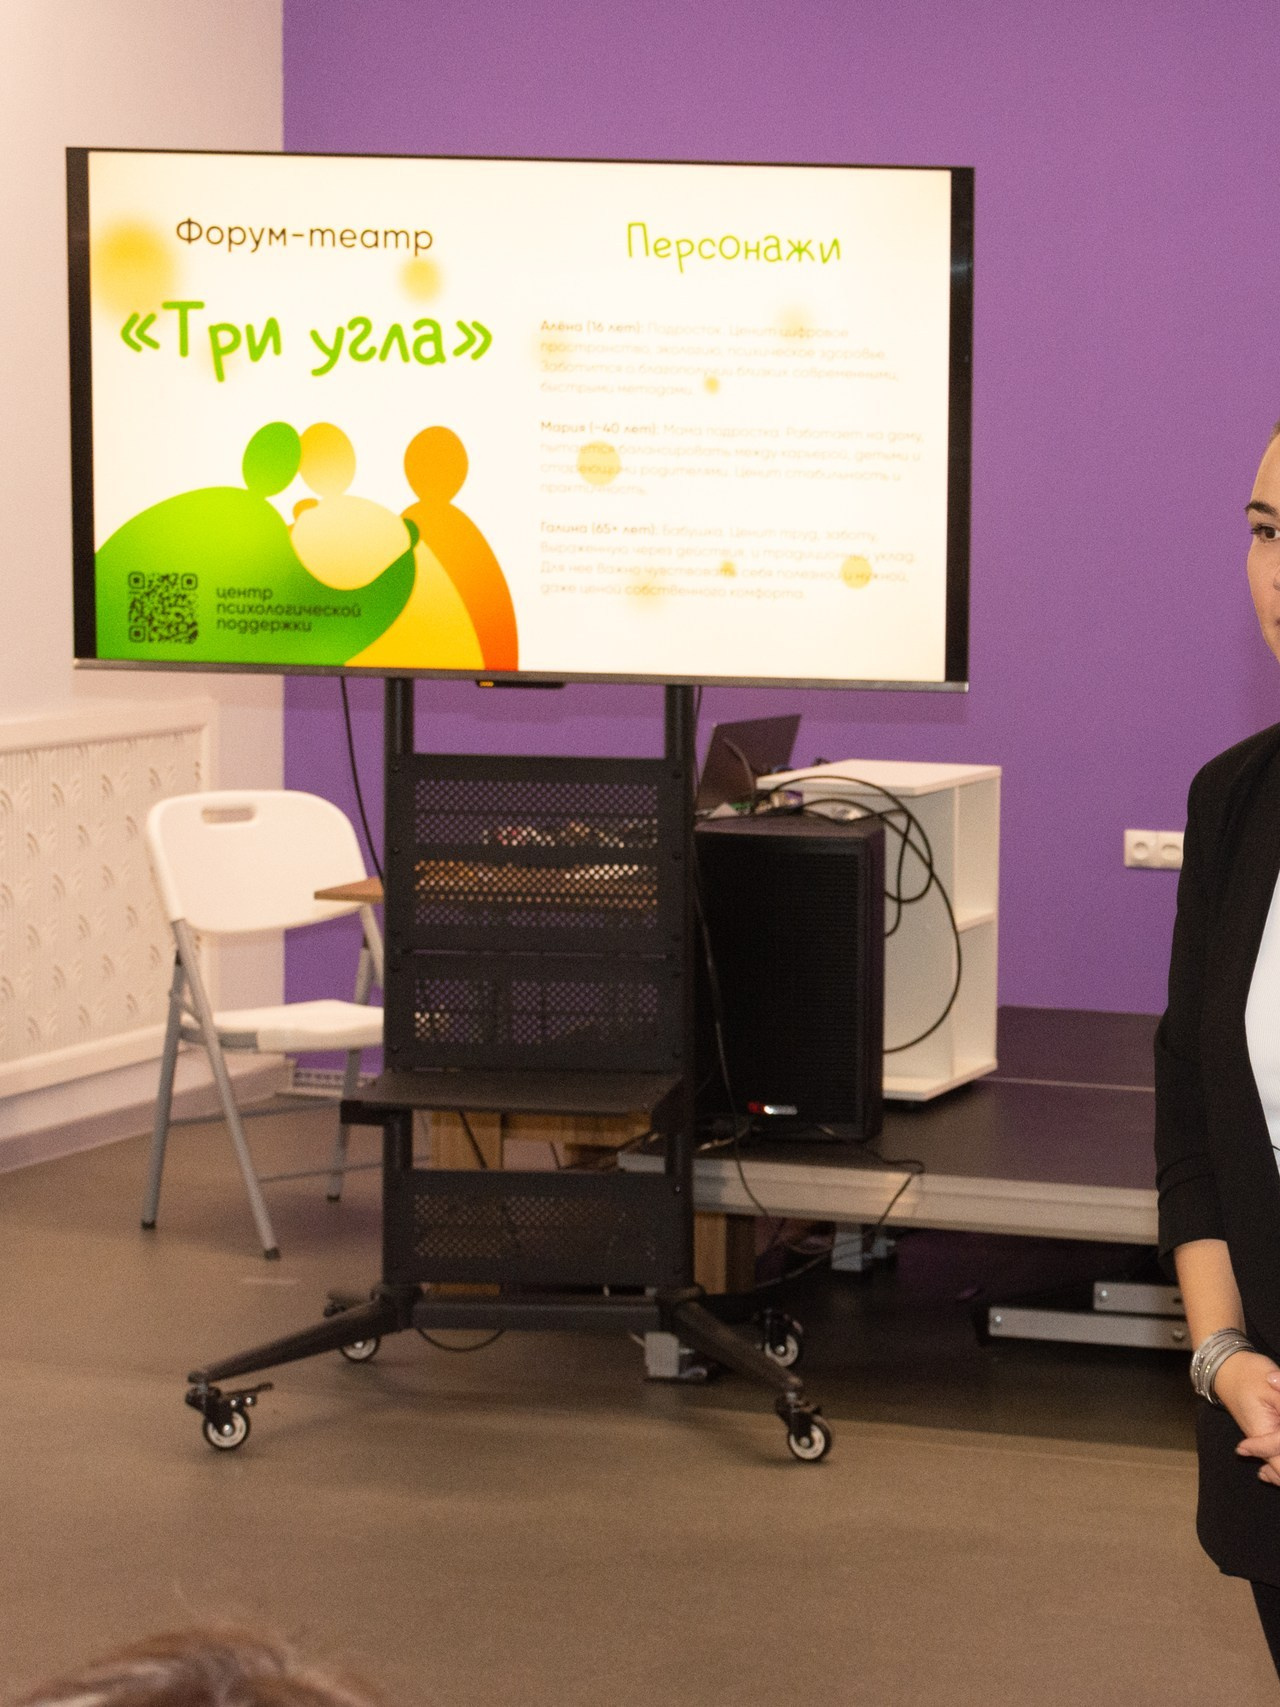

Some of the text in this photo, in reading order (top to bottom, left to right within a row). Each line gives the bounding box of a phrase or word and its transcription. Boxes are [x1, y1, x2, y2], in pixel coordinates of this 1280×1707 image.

[176, 217, 433, 257] Форум-театр
[627, 221, 841, 274] Персонажи
[121, 301, 492, 382] «Три угла»
[540, 420, 586, 434] Мария
[540, 521, 588, 534] Галина
[216, 587, 273, 602] центр
[216, 601, 362, 619] психологической
[216, 617, 313, 635] поддержки
